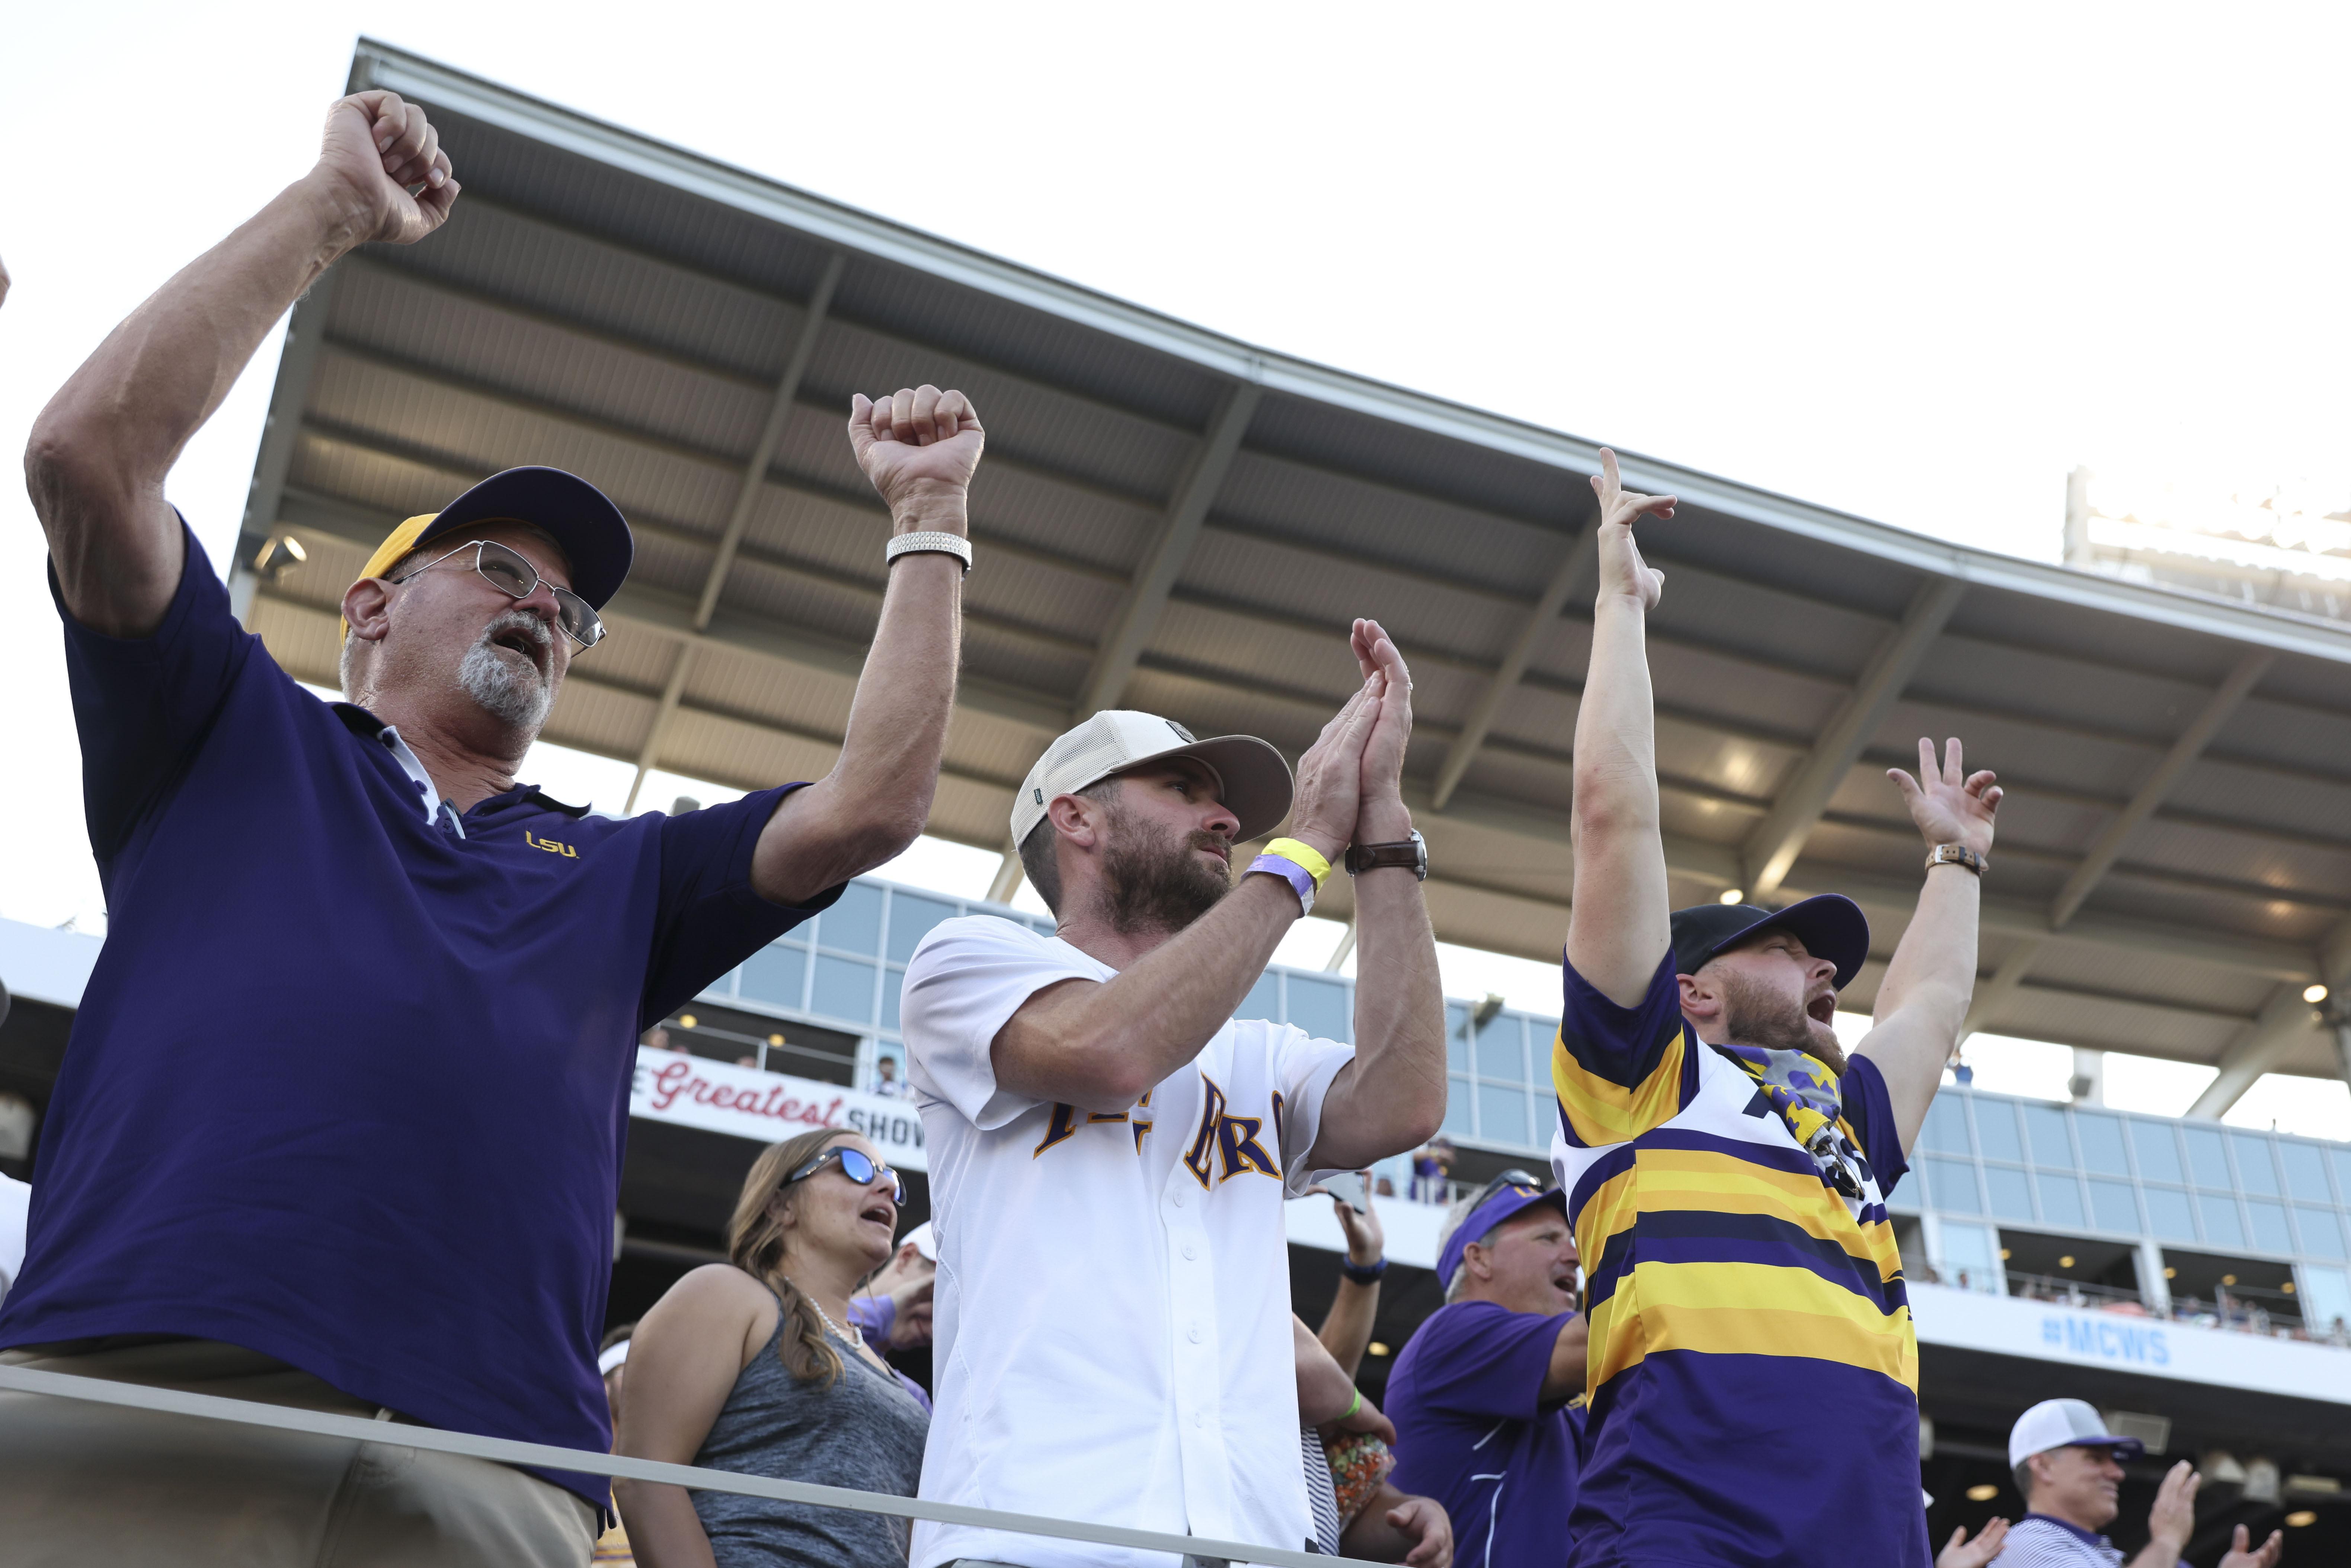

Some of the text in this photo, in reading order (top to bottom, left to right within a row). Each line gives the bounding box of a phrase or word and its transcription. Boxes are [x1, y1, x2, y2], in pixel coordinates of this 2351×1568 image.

[526, 830, 577, 857] LSU
[651, 1061, 842, 1129] Greatest
[2043, 1316, 2169, 1366] #MCWS
